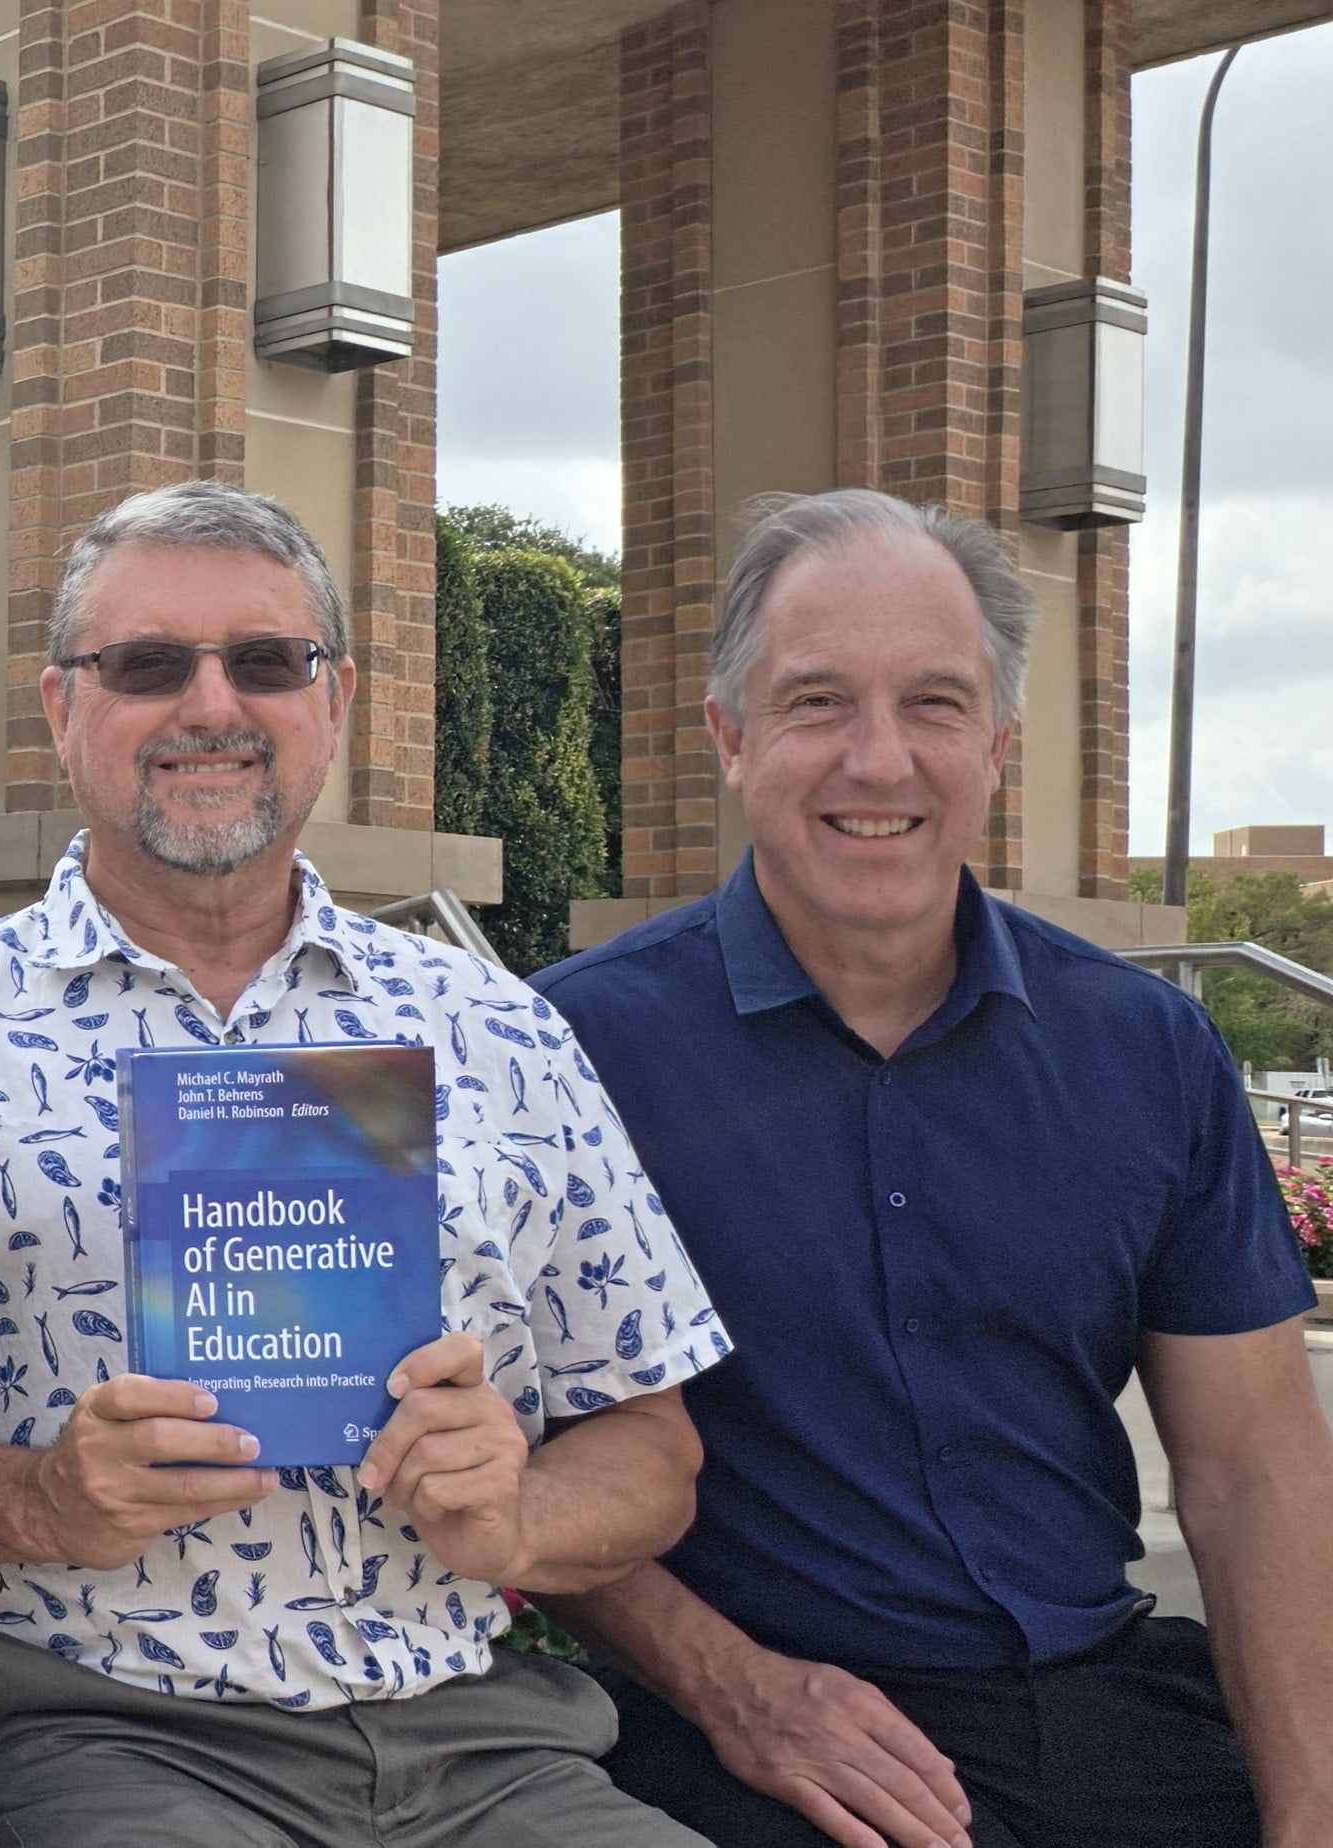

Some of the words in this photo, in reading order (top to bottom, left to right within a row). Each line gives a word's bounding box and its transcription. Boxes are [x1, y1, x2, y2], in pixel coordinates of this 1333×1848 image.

[177, 1072, 221, 1086] Michael
[223, 1071, 234, 1085] C.
[237, 1070, 284, 1087] Mayrath
[178, 1089, 204, 1103] John
[206, 1089, 215, 1102] T.
[218, 1088, 264, 1102] Behrens
[178, 1106, 214, 1120] Daniel
[216, 1107, 229, 1119] H.
[232, 1105, 284, 1118] Robinson
[291, 1103, 329, 1117] Editors
[183, 1189, 345, 1228] Handbook
[184, 1236, 217, 1273] of
[223, 1234, 395, 1272] Generative
[186, 1281, 216, 1317] AI
[226, 1282, 256, 1316] in
[188, 1325, 342, 1361] Education
[254, 1374, 304, 1388] Research
[306, 1374, 328, 1388] into
[331, 1372, 375, 1387] Practice
